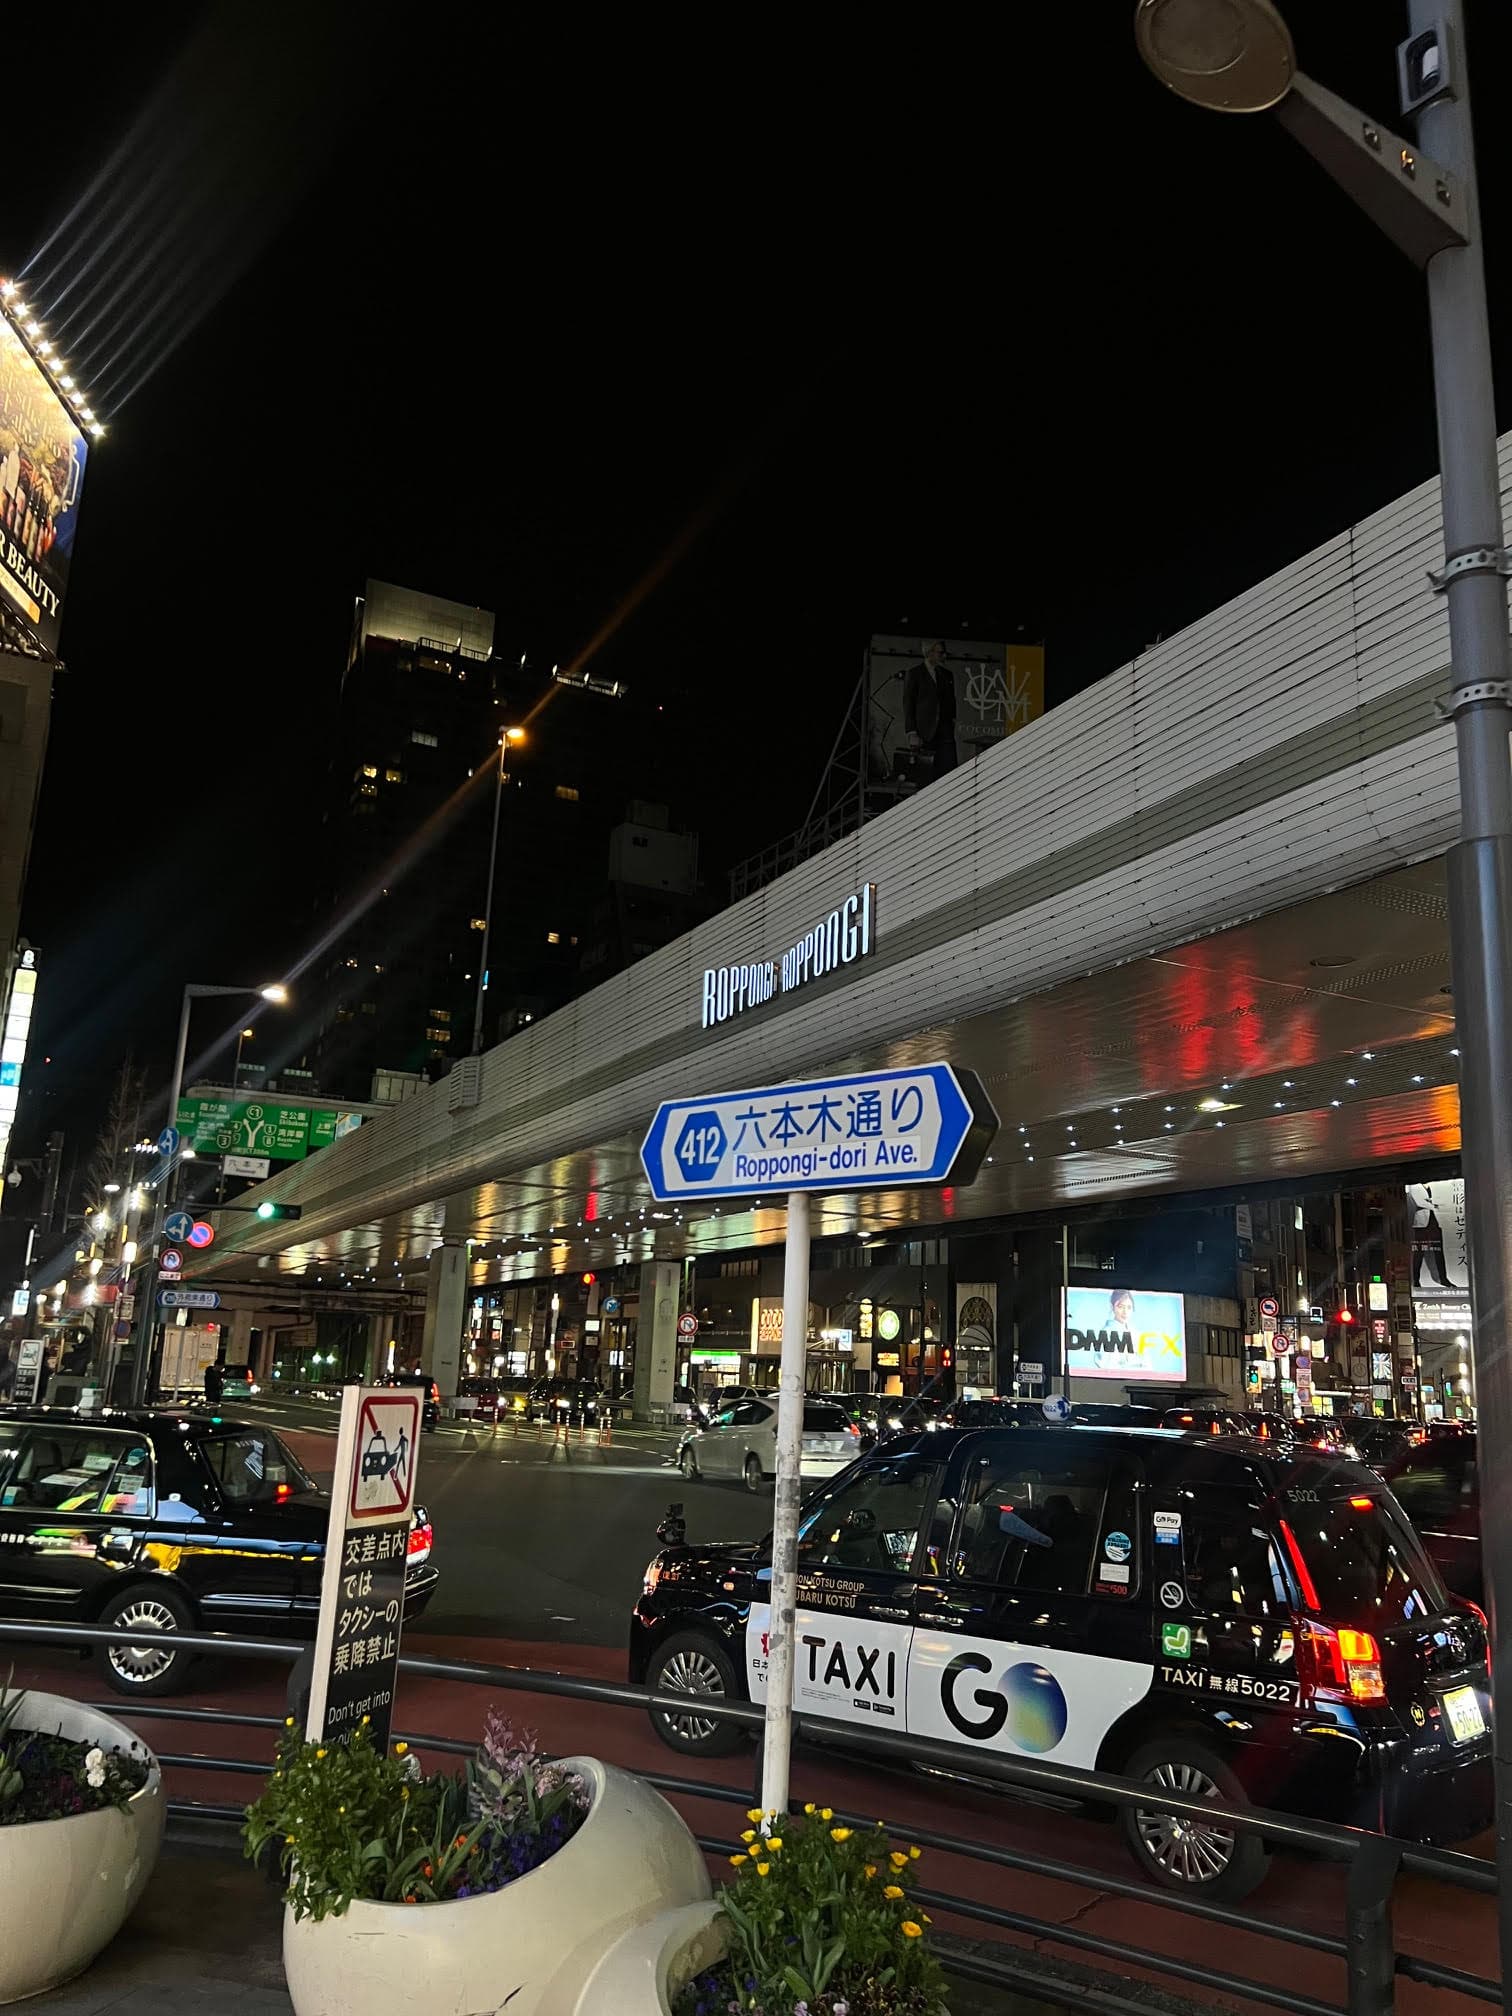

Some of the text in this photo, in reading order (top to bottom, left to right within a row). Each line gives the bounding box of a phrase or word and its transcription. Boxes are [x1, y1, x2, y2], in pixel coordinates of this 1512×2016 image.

[7, 542, 60, 617] BEAUTY
[702, 882, 870, 1029] ROPPONGI ROPPONGI
[732, 1085, 924, 1151] 六本木通り
[680, 1126, 720, 1166] 412
[736, 1140, 918, 1182] Roppongi-dori Ave.
[1065, 1329, 1182, 1358] DMM FX
[345, 1529, 406, 1567] 交差点内
[343, 1569, 373, 1599] では
[825, 1594, 856, 1609] KOTSU
[836, 1580, 864, 1593] GROUP
[338, 1599, 400, 1638] タクシーの
[333, 1631, 396, 1675] 乗降禁止
[802, 1634, 896, 1699] TAXI
[1161, 1666, 1204, 1688] TAXI
[328, 1690, 391, 1725] Don't get into
